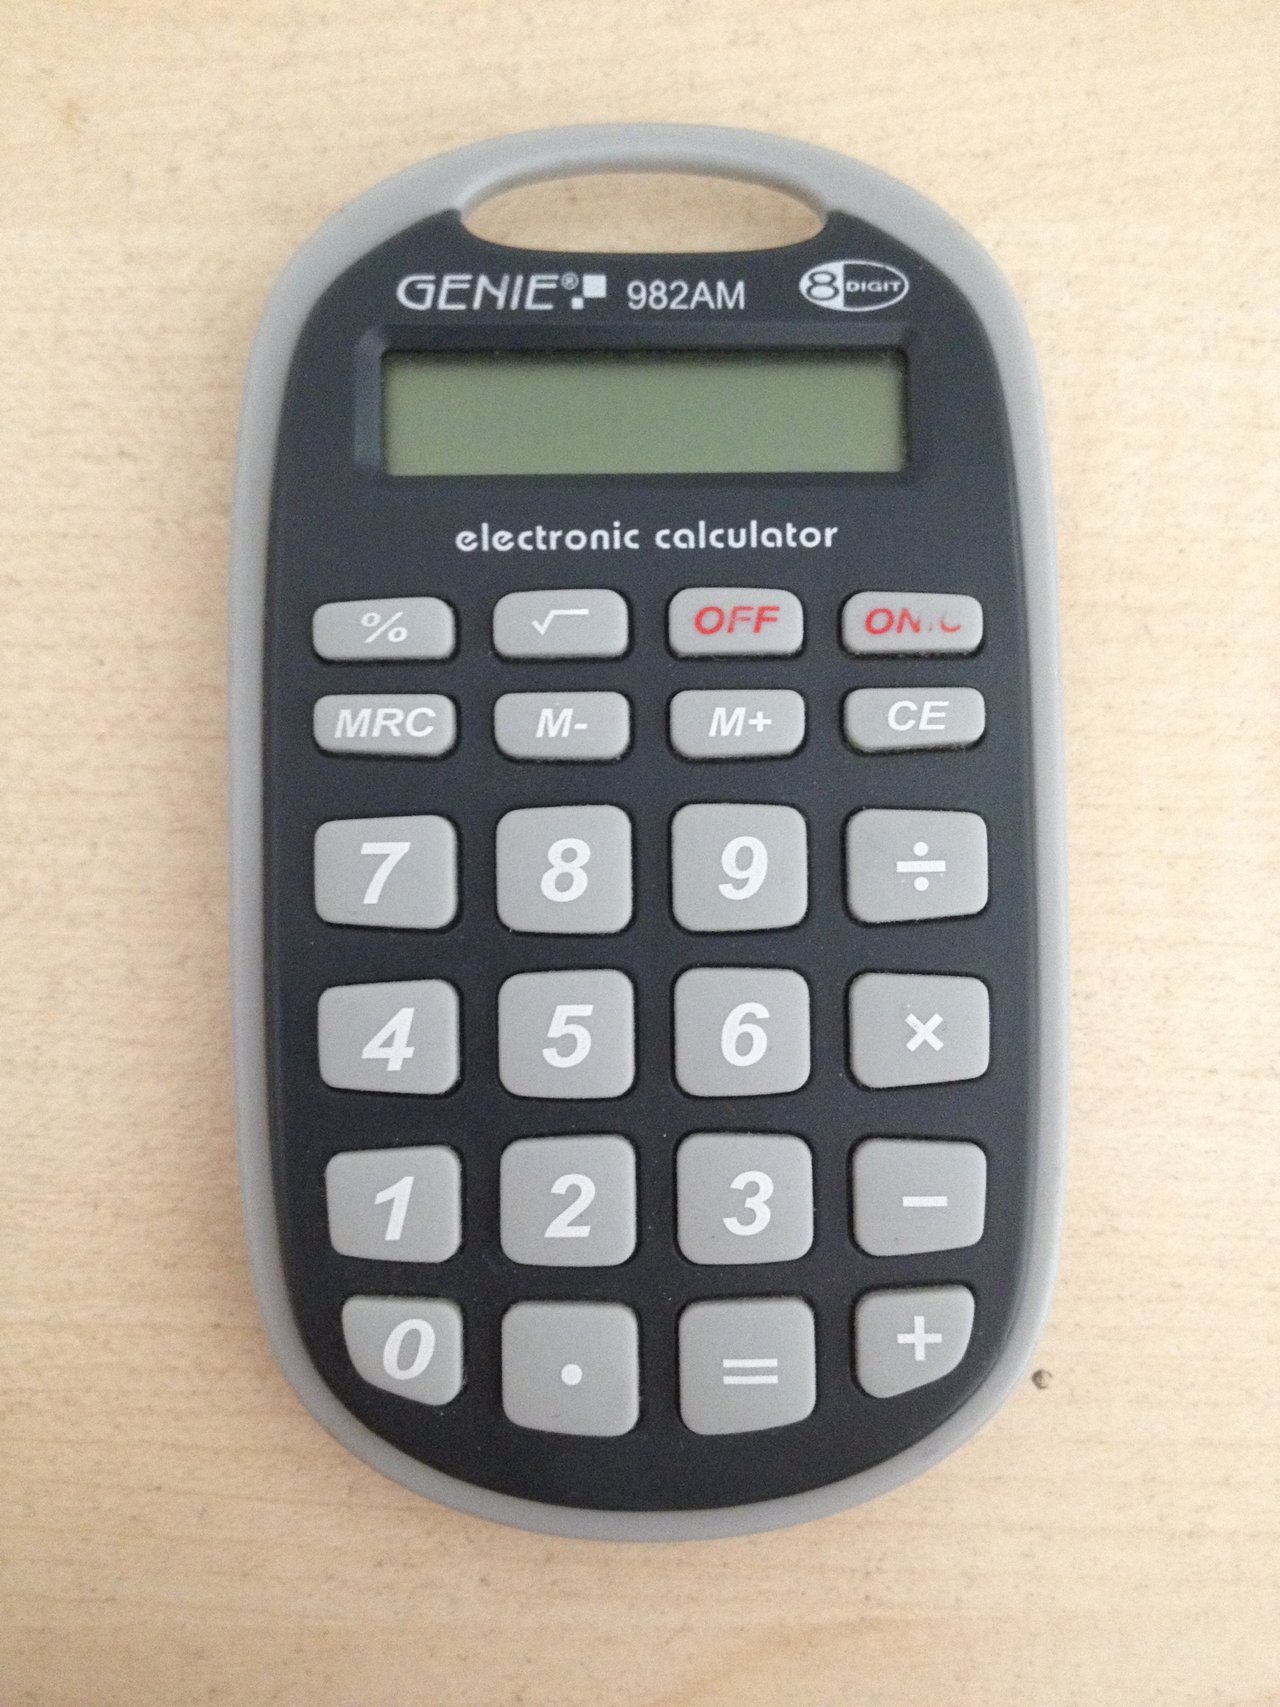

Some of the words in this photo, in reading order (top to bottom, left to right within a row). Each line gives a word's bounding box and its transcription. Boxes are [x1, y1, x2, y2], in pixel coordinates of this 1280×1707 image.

[626, 279, 746, 310] 982AM
[806, 271, 840, 301] 8
[845, 280, 901, 293] DIGIT
[455, 522, 640, 552] electronic
[654, 520, 838, 549] calculator
[694, 605, 780, 635] OFF
[334, 707, 436, 738] MRC
[535, 708, 588, 738] M-
[708, 707, 772, 738] M+
[887, 700, 950, 732] CE
[359, 842, 411, 905] 7
[540, 838, 591, 902] 8
[717, 836, 769, 900] 9
[362, 1007, 416, 1072] 4
[542, 1004, 594, 1068] 5
[720, 1002, 770, 1067] 6
[373, 1176, 414, 1241] 1
[544, 1174, 597, 1238] 2
[722, 1171, 775, 1236] 3
[382, 1318, 436, 1380] 0
